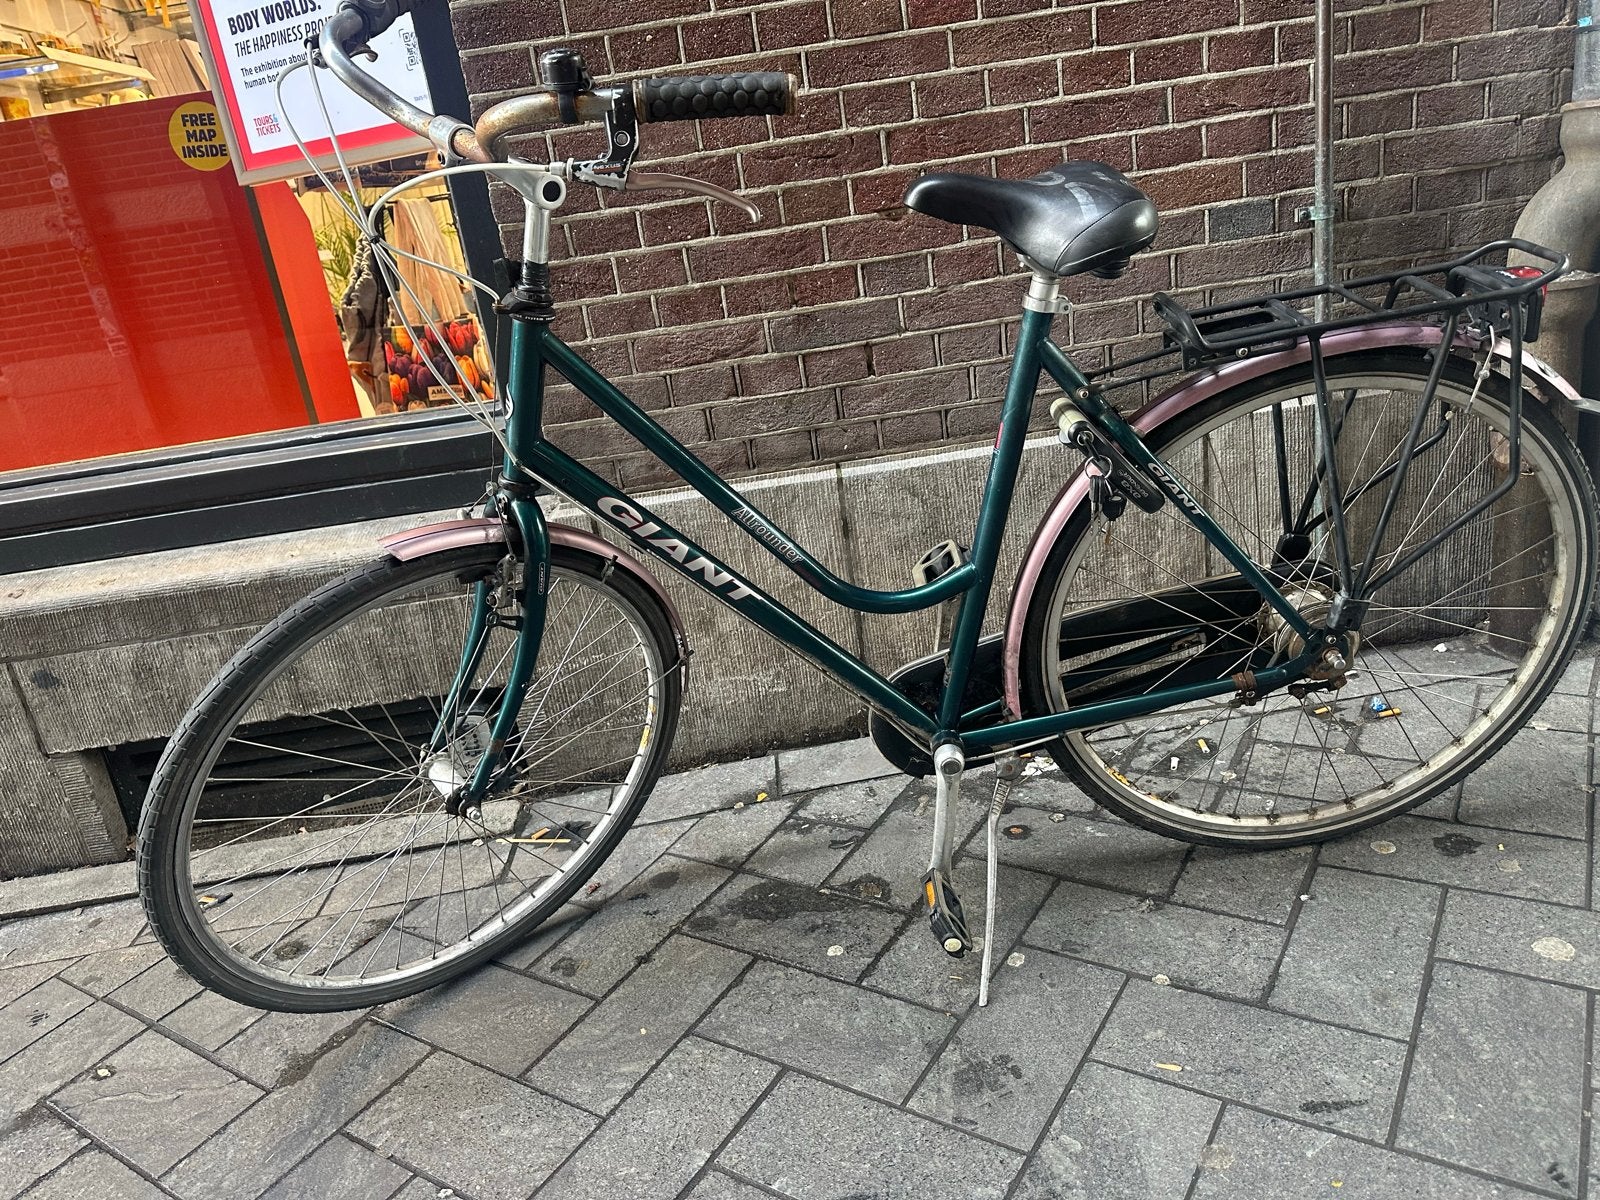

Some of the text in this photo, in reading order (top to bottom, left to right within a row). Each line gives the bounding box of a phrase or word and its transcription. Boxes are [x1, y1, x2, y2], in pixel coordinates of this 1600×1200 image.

[227, 9, 260, 36] BODY
[234, 39, 252, 58] THE
[252, 24, 304, 53] HAPPINESS
[240, 51, 308, 78] The exhibition about
[243, 76, 267, 90] human
[181, 112, 216, 128] FREE
[255, 123, 281, 137] TICKETS
[185, 129, 217, 143] MAP
[181, 144, 228, 159] INSIDE
[1147, 462, 1205, 517] GIANT
[731, 504, 805, 565] Allrounder
[597, 496, 764, 601] GIANT
